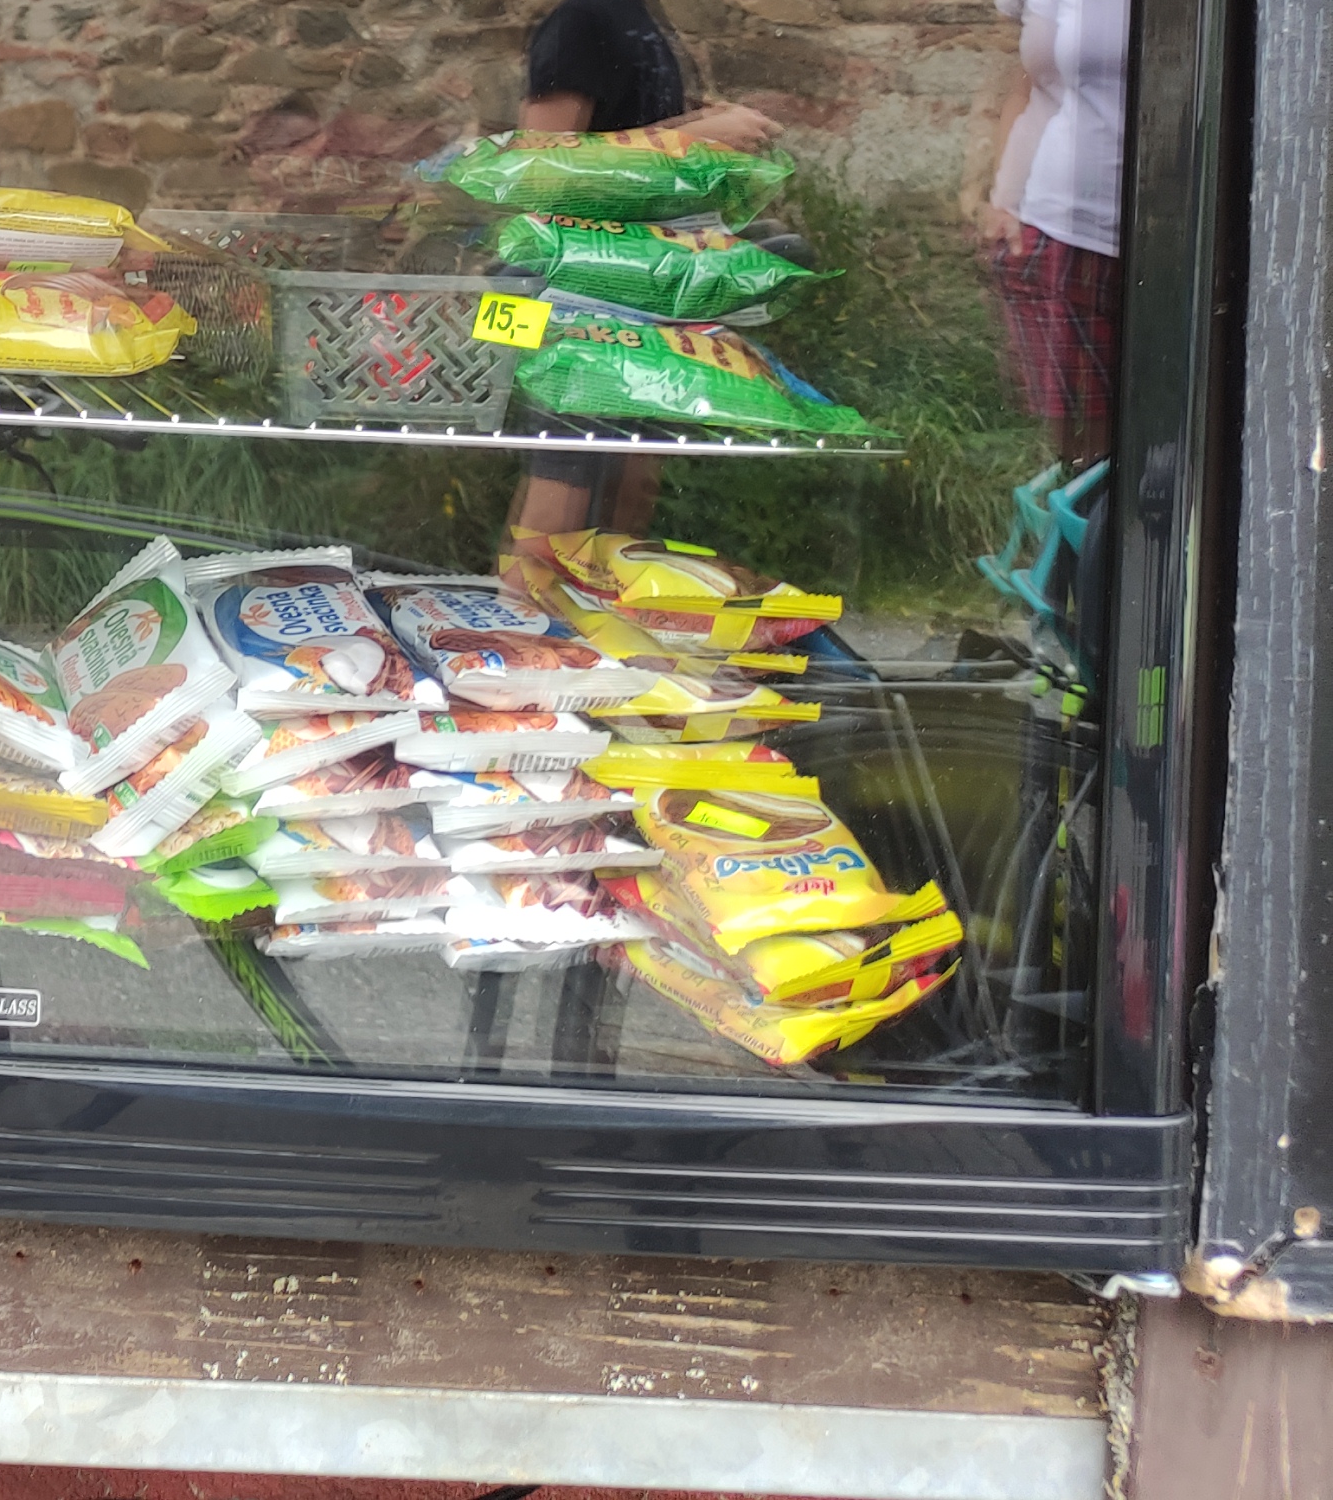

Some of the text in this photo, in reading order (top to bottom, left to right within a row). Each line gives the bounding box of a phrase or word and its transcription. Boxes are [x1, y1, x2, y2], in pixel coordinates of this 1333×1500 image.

[482, 299, 529, 340] 15,-
[254, 590, 313, 636] Ovesná
[294, 584, 349, 634] svačinka
[77, 628, 115, 690] svačinka
[103, 607, 148, 669] Ovesná
